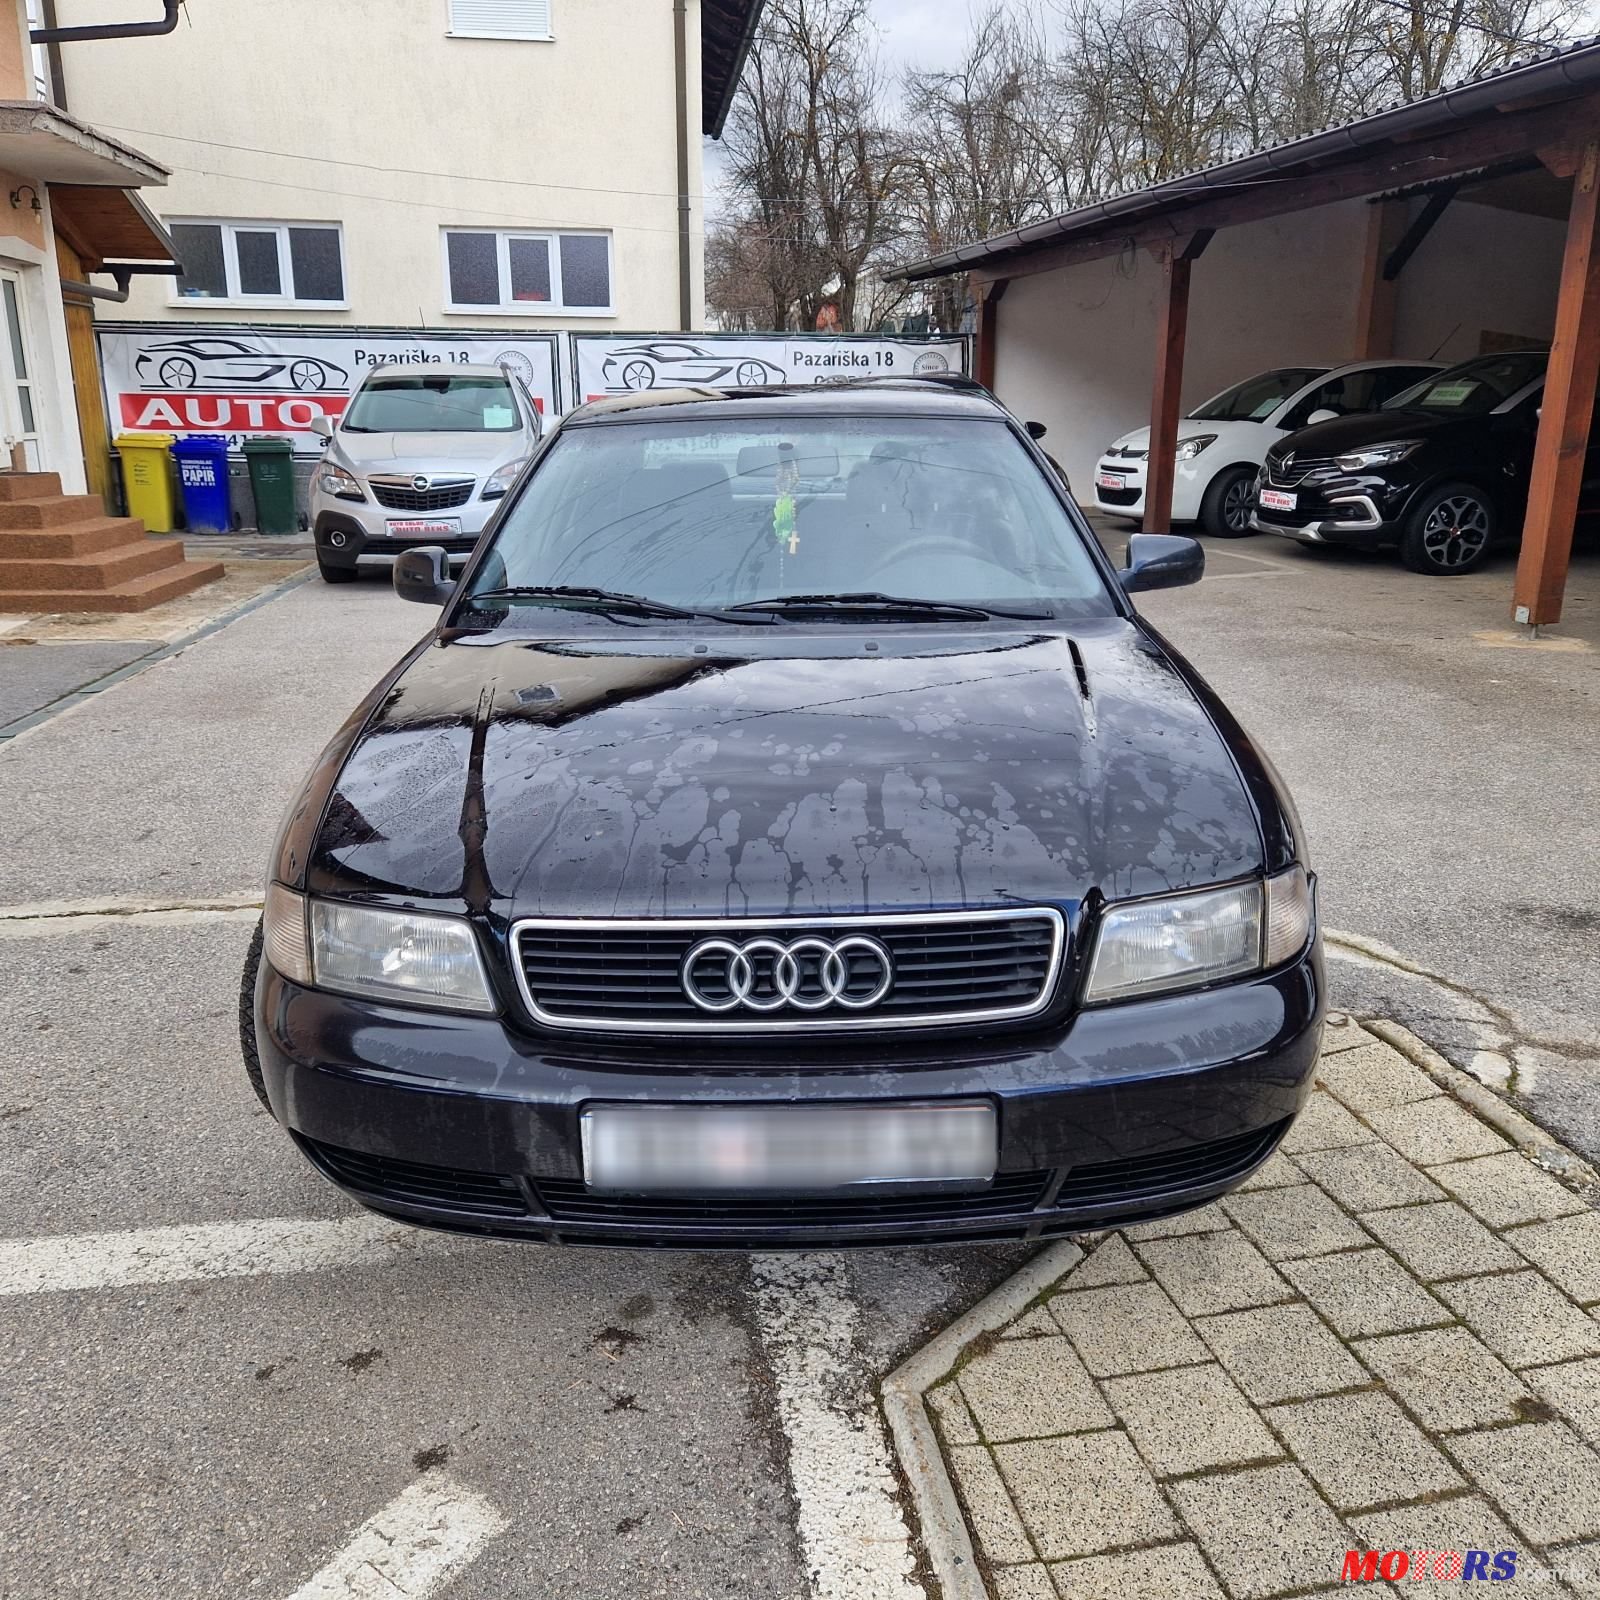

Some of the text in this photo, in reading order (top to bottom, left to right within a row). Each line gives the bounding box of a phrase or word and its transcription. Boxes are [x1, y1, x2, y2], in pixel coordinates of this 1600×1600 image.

[448, 351, 470, 364] 18
[793, 350, 894, 367] Pazariška 18
[182, 469, 215, 482] PAPIR
